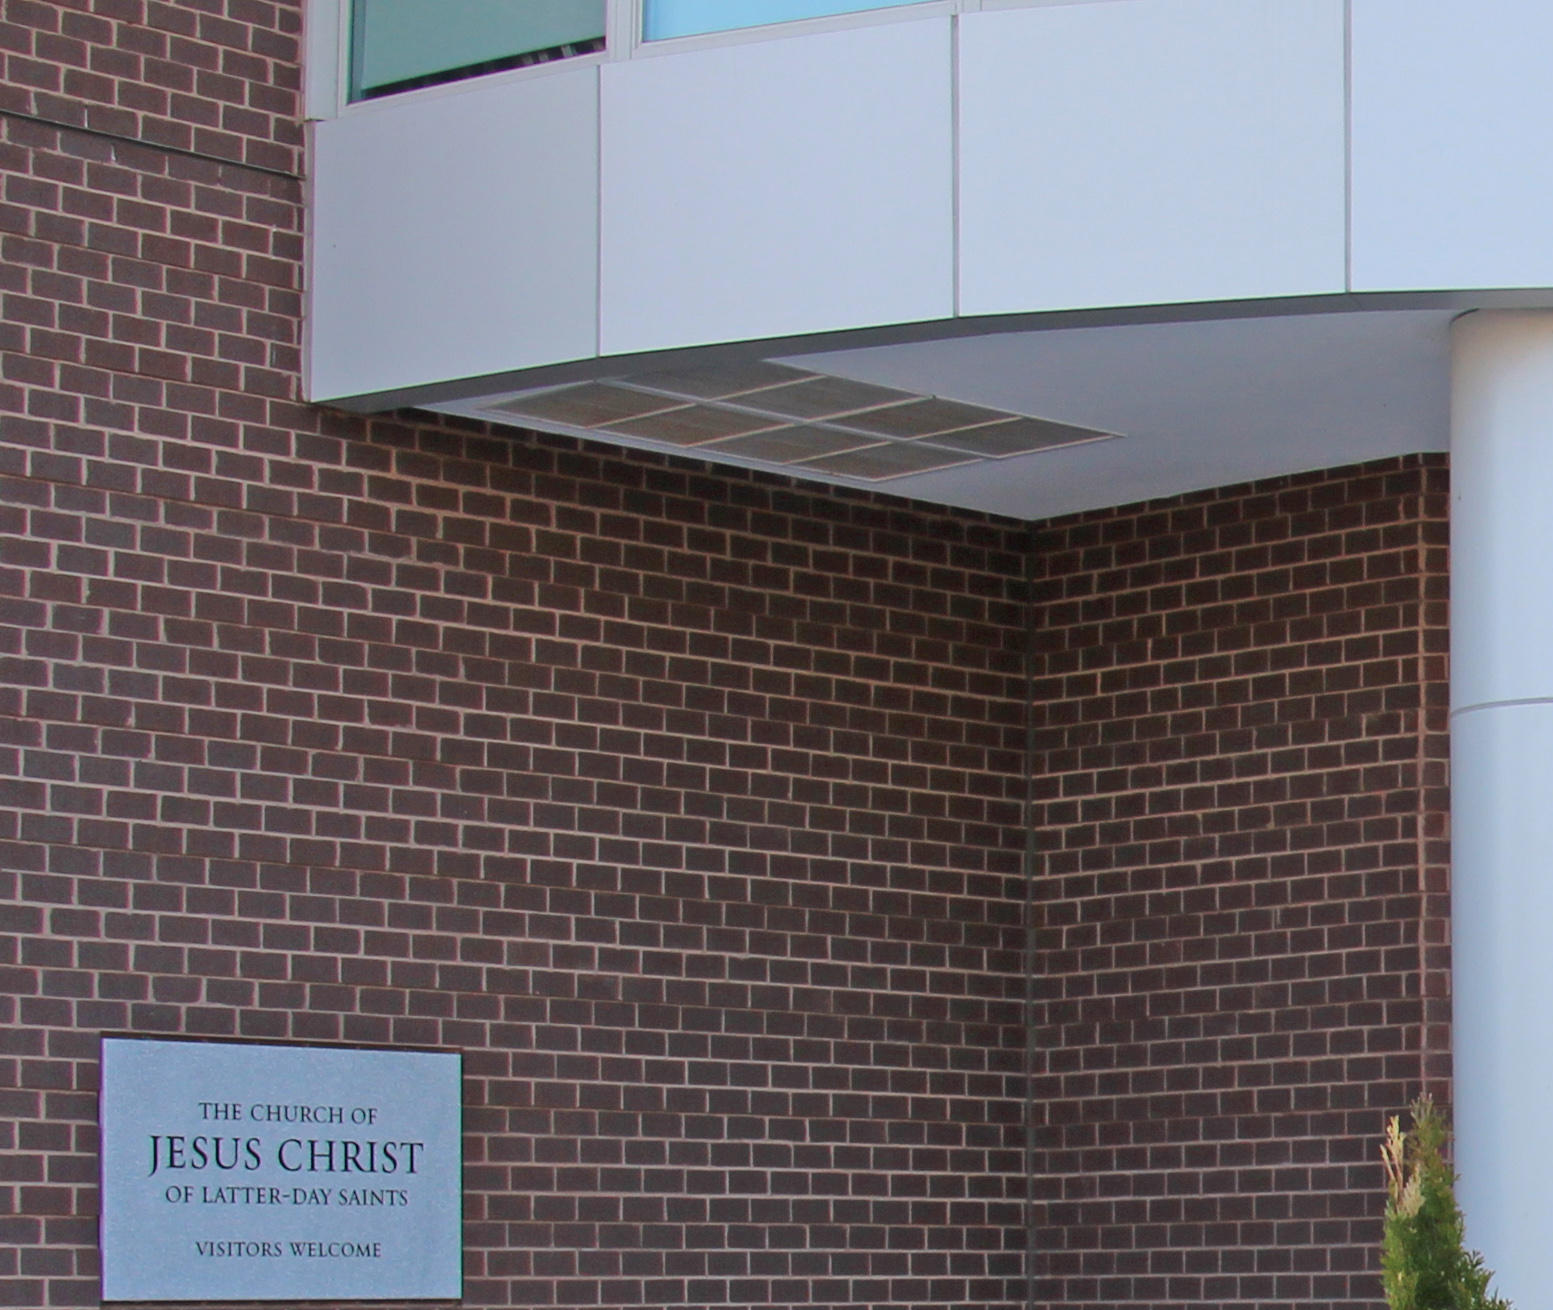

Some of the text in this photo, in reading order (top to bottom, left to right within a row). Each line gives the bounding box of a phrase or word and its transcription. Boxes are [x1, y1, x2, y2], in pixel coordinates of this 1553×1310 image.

[198, 1102, 378, 1126] THE CHURCH OF
[148, 1134, 425, 1178] JESUS CHRIST
[164, 1185, 408, 1207] OF LATTER-DAY SAINTS
[194, 1240, 382, 1258] VISITORS WELCOME
